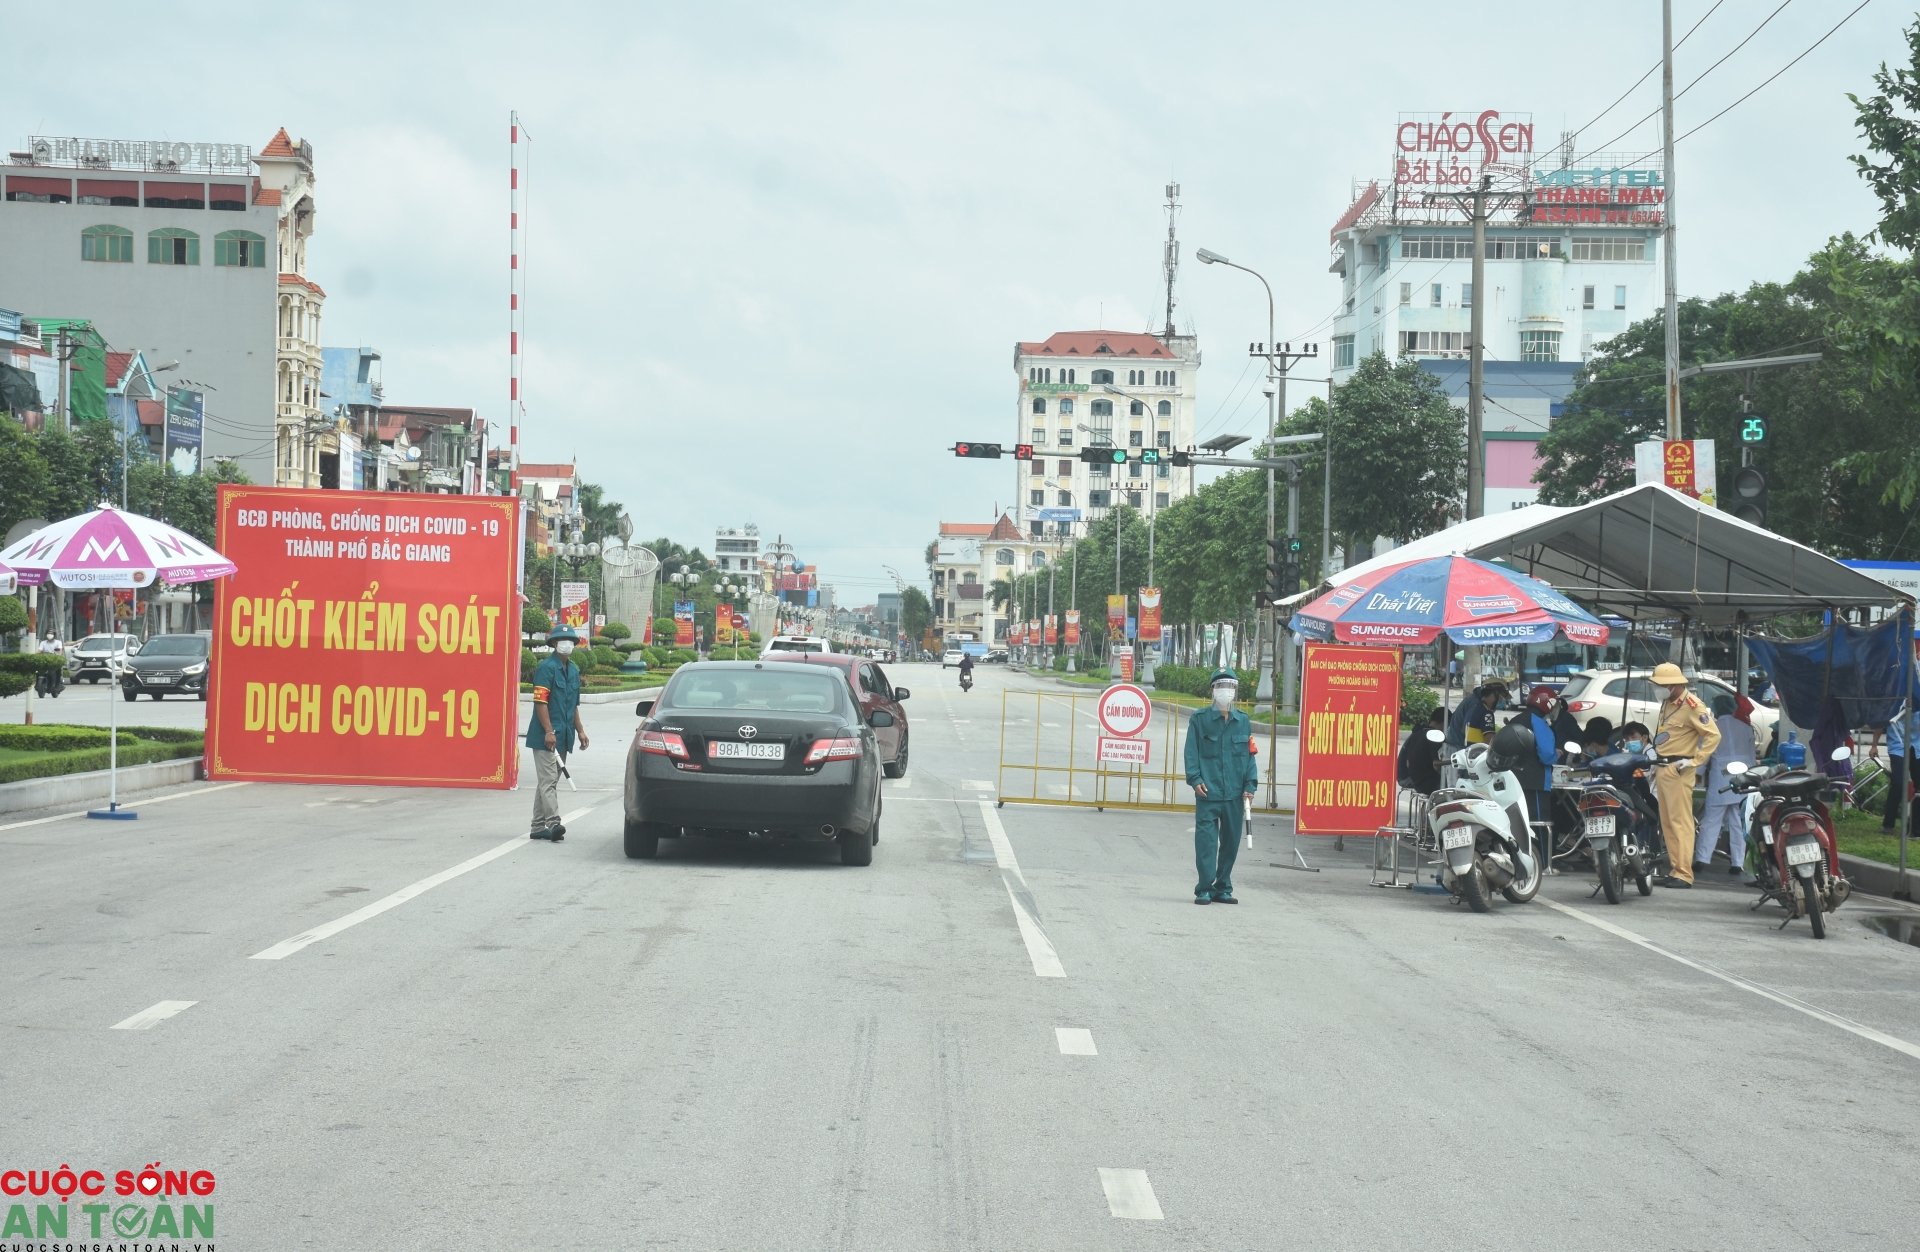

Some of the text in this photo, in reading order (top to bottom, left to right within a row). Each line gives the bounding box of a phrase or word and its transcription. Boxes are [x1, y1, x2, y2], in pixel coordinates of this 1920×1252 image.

[1397, 110, 1534, 165] CHÁO SEN
[149, 140, 250, 167] HOTEL
[1396, 156, 1472, 185] Bát bảo
[1533, 207, 1602, 222] ASAHI
[1027, 378, 1090, 394] Kangaroo
[1742, 419, 1764, 441] 25
[1017, 446, 1032, 458] 27
[1143, 450, 1157, 462] 24
[1672, 475, 1687, 484] XV
[238, 509, 267, 528] BCĐ
[272, 507, 326, 532] PHÒNG,
[331, 508, 381, 532] CHỐNG
[385, 516, 420, 537] DỊCH
[424, 516, 467, 536] COVID
[481, 519, 499, 537] 19
[286, 536, 451, 562] THÀNH PHỐ BẮC GIANG
[1290, 541, 1300, 550] 24
[59, 573, 96, 582] MUTOSI
[168, 568, 196, 578] MUTOSI
[1900, 580, 1918, 588] GIANG
[1405, 596, 1437, 615] Việt
[1462, 600, 1516, 608] SUNHOUSE
[230, 580, 500, 655] CHỐT KIỂM SOÁT
[565, 615, 585, 627] XV
[1300, 617, 1327, 632] SUNHOUSE
[1350, 625, 1419, 637] SUNHOUSE
[1463, 625, 1535, 639] SUNHOUSE
[1566, 624, 1600, 637] SUNHOUSE
[1310, 660, 1319, 669] BAN
[1337, 659, 1352, 671] PHÒNG
[1352, 659, 1368, 671] CHỐNG
[1368, 663, 1379, 674] DỊCH
[245, 681, 480, 743] DỊCH COVID-19
[1106, 701, 1143, 718] CẤM ĐƯỜNG
[1308, 695, 1393, 756] CHỐT KIỂM SOÁT
[1306, 779, 1388, 811] DỊCH COVID-19
